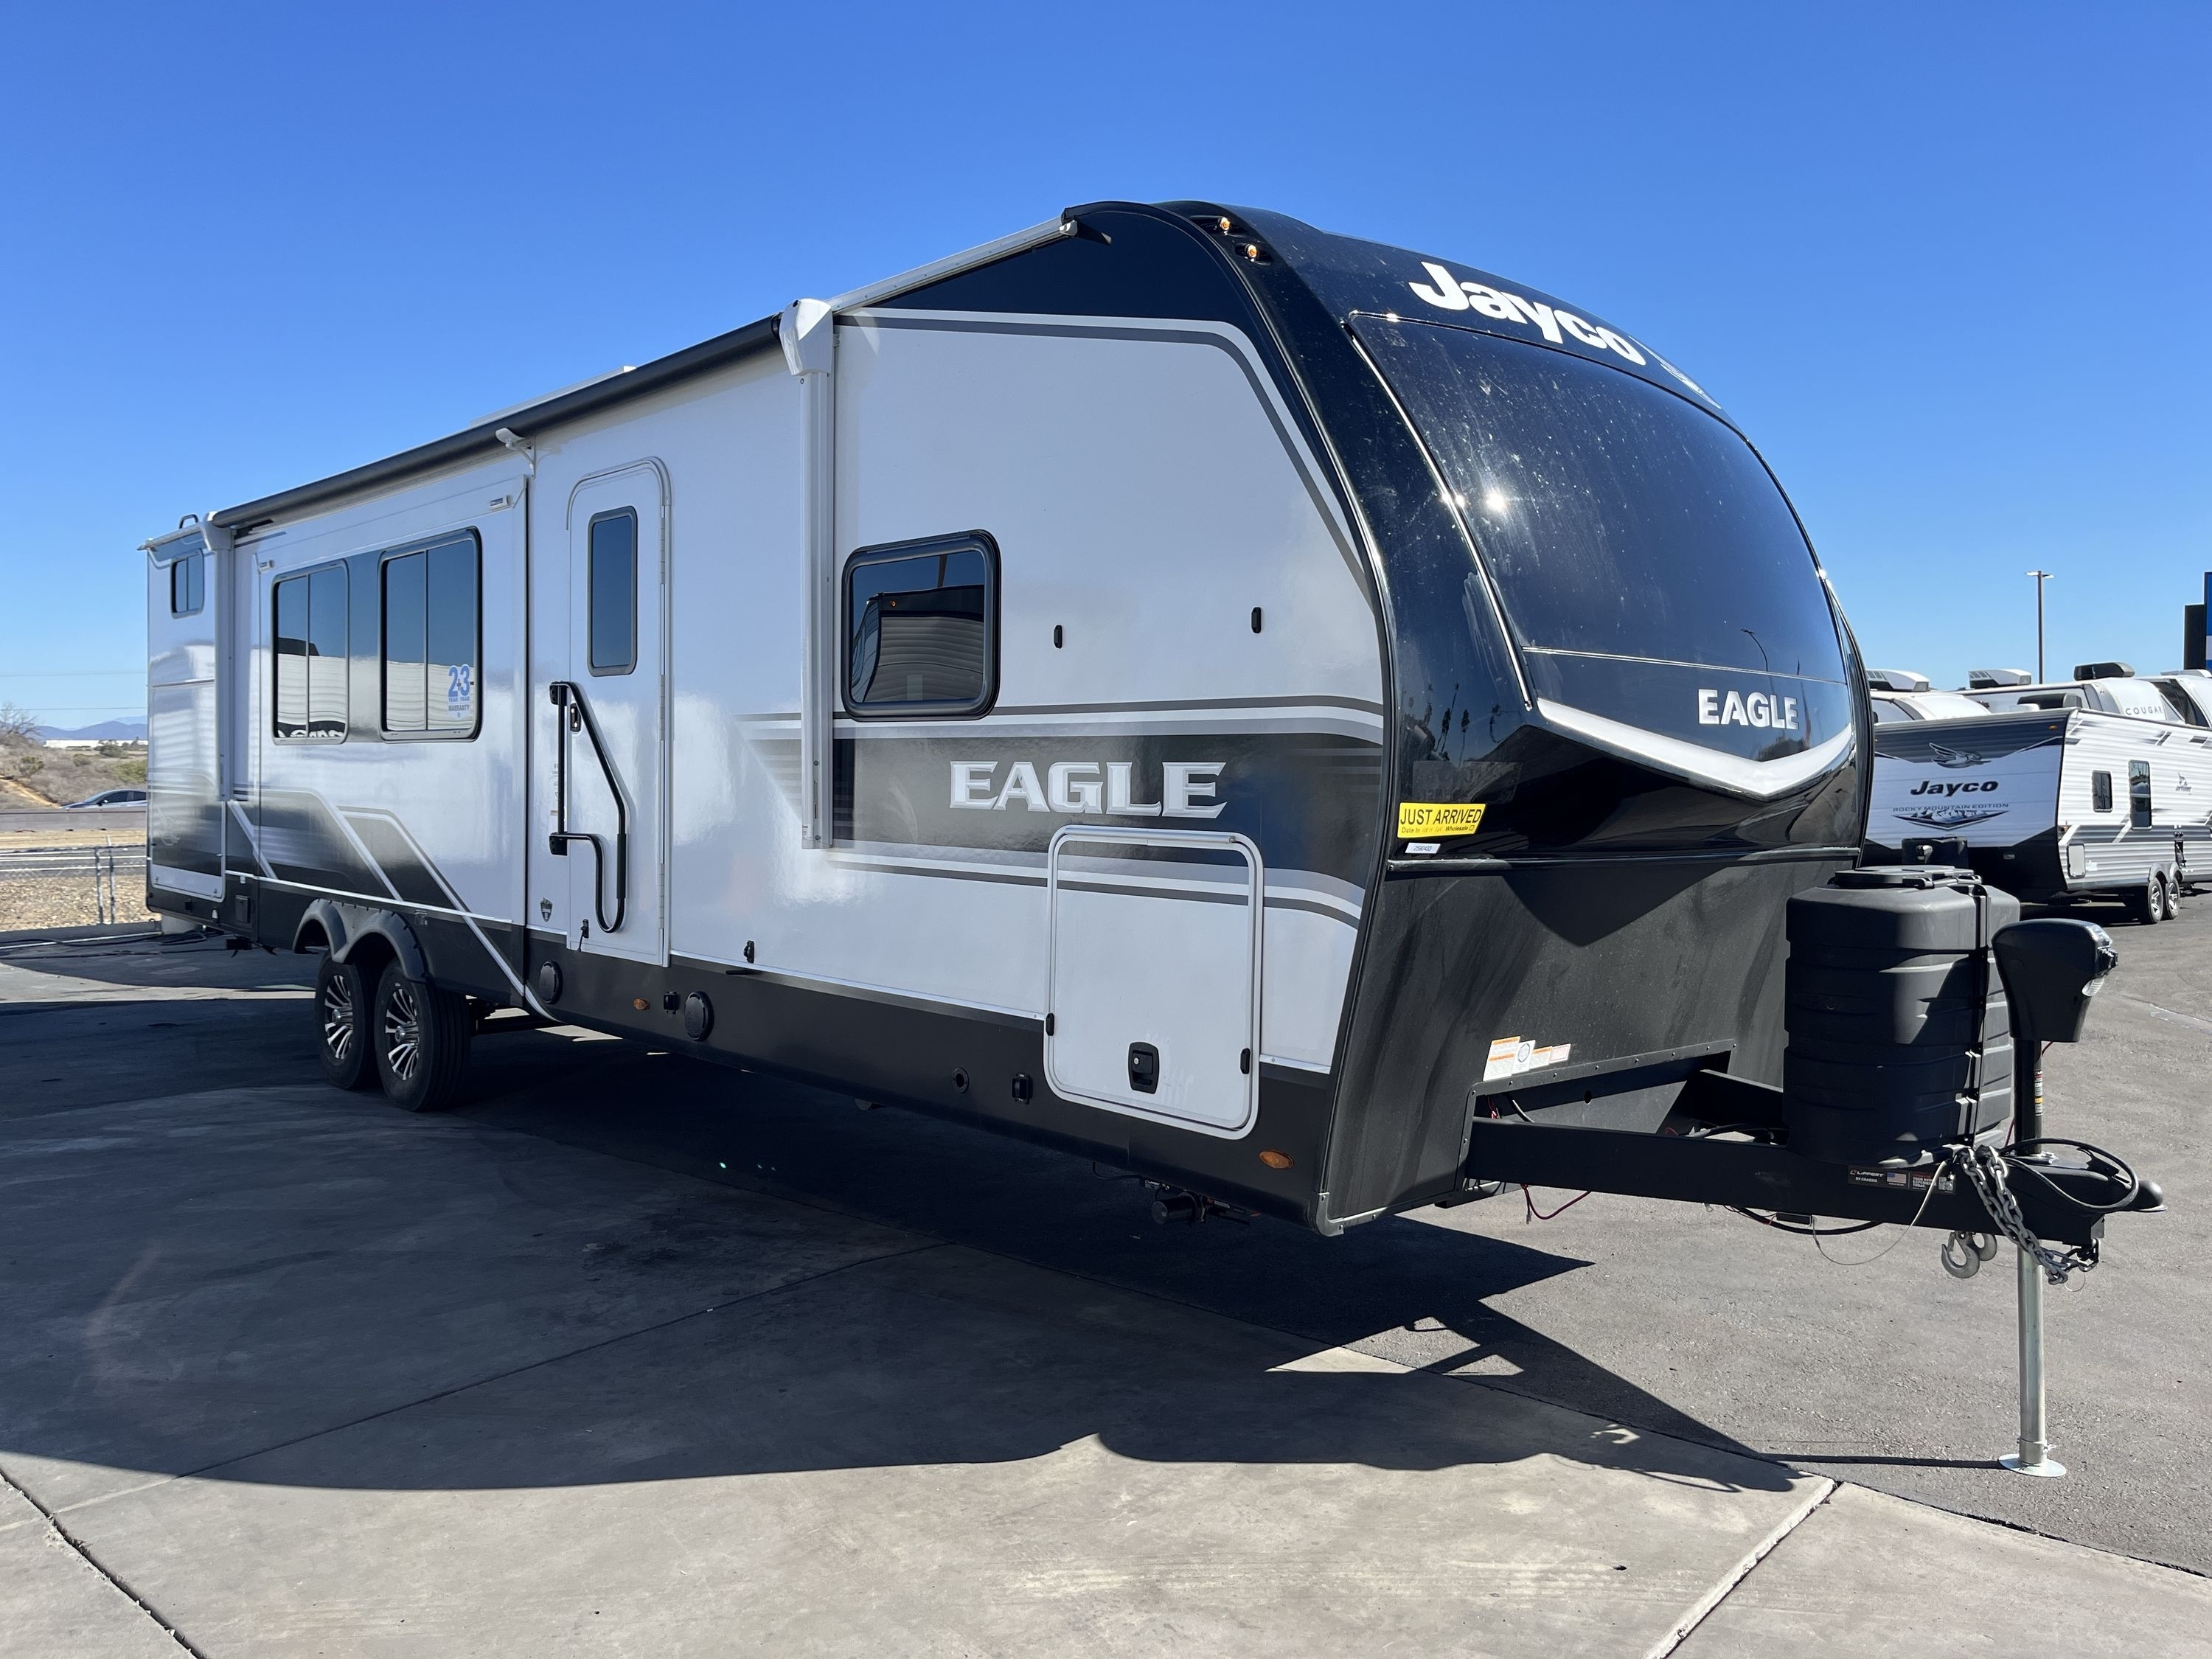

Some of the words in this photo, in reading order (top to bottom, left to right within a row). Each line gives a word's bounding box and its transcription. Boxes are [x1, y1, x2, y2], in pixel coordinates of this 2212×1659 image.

[1409, 261, 1646, 366] Jayco
[1697, 689, 1799, 730] EAGLE
[950, 761, 1227, 818] EAGLE
[1910, 780, 1998, 797] Jayco
[1400, 809, 1433, 824] JUST
[1433, 809, 1481, 824] ARRIVED
